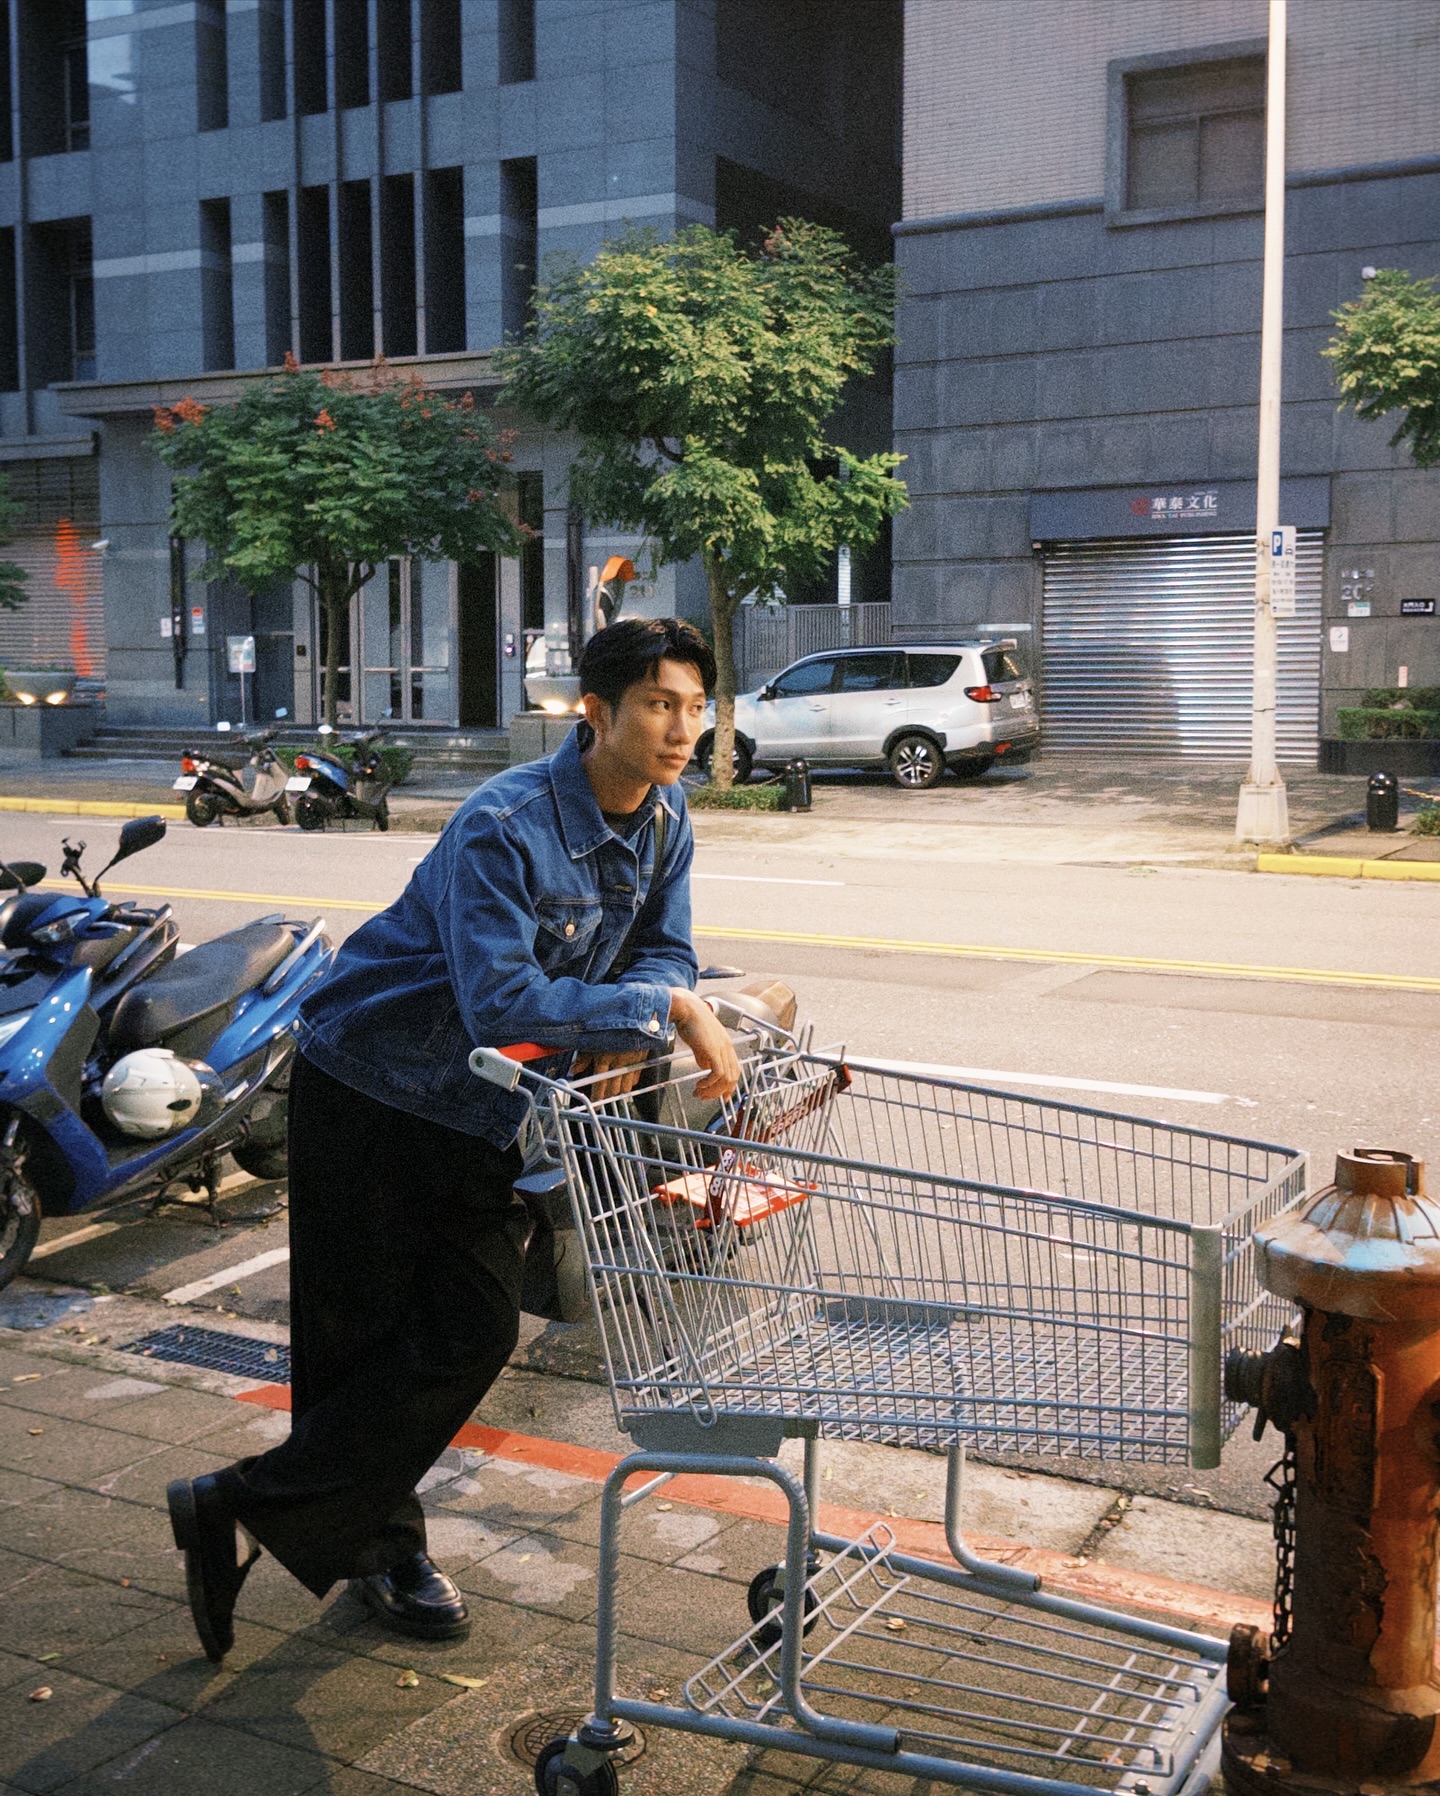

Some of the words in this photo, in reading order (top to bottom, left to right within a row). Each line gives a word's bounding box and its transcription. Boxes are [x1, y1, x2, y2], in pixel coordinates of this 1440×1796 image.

[1151, 495, 1218, 511] 華泰文化
[1273, 535, 1282, 552] P
